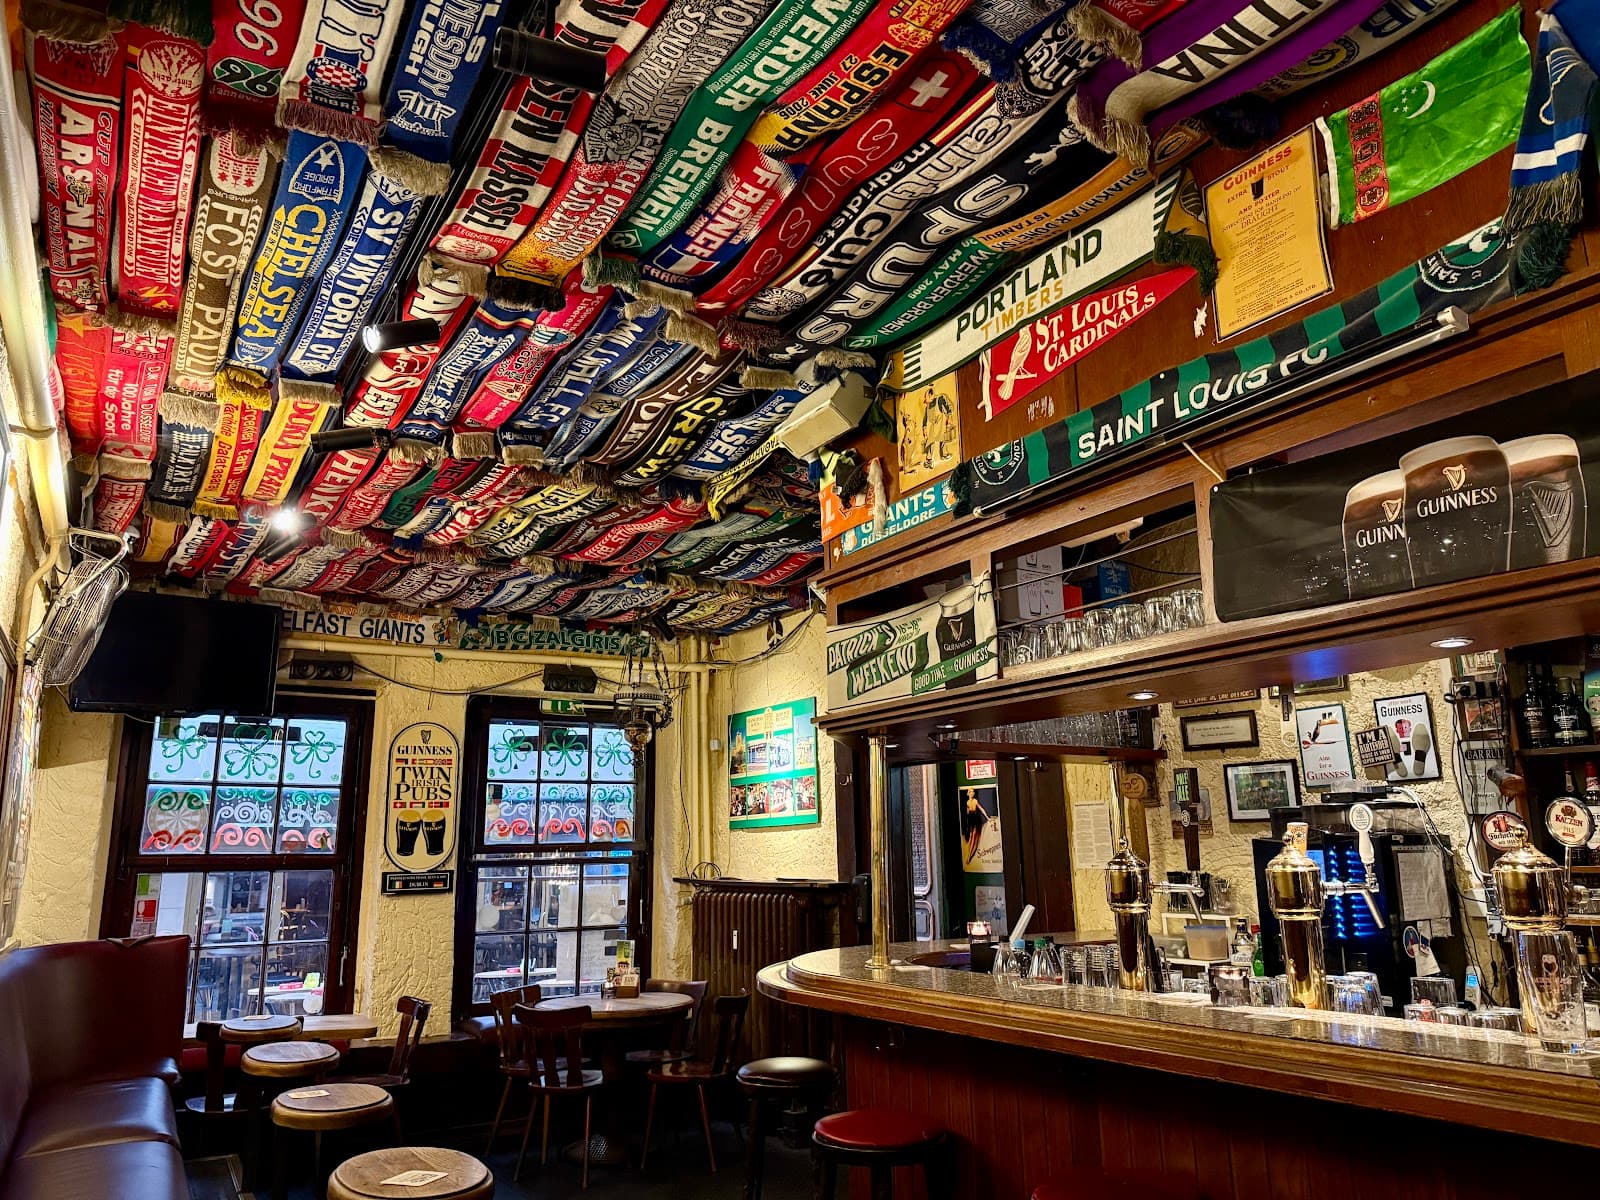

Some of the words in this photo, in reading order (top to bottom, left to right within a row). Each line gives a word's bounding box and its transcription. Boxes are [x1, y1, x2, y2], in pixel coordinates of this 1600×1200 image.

[212, 56, 279, 97] 96
[620, 5, 706, 121] SONDERZUG
[714, 0, 849, 115] WERDER
[839, 53, 859, 73] 27
[780, 97, 810, 121] 2006
[809, 72, 839, 100] JUNE
[97, 111, 114, 168] CUP
[140, 94, 191, 197] EINTRACHT
[60, 103, 96, 269] ARSNAL
[292, 179, 341, 199] STAMFORD
[302, 170, 336, 186] BRIDGE
[460, 140, 552, 231] KASSEL
[617, 146, 652, 187] NACH
[627, 115, 736, 232] BREMEN
[1223, 146, 1293, 191] GUINNESS
[1227, 188, 1248, 204] EXTRA
[1267, 164, 1290, 182] STOUT
[682, 166, 783, 260] FRANCE
[813, 141, 932, 248] madridista
[1240, 204, 1280, 230] DRAUGHT
[134, 194, 177, 285] FRANKFURT
[206, 203, 250, 248] FC
[363, 206, 406, 247] SV
[976, 211, 1050, 242] ISTANBUL
[243, 204, 328, 339] CHELSEA
[796, 174, 1030, 346] SPURS
[935, 248, 965, 278] MAY
[936, 248, 996, 301] WERDER
[315, 252, 386, 342] VIKTORIA
[956, 227, 1103, 343] PORTLAND
[301, 289, 328, 344] UNTERMAIN
[876, 288, 936, 337] BREMEN
[980, 280, 1064, 342] TIMBERS
[1035, 311, 1066, 353] ST.
[1071, 282, 1139, 331] LOUIS
[1042, 290, 1157, 374] CARDINALS
[184, 306, 227, 379] PAULI
[548, 320, 645, 400] MILLWALL
[1077, 398, 1166, 460] SAINT
[1173, 361, 1269, 420] LOUIS
[636, 396, 725, 479] CREW
[859, 487, 936, 534] GANTS
[1416, 486, 1498, 518] GUINNESS
[277, 611, 353, 636] ELFAST
[359, 617, 427, 645] GIANTS
[827, 621, 897, 672] PATRICK'S
[943, 638, 974, 652] GUINNESS
[850, 641, 918, 697] WEEKEND
[914, 673, 931, 692] GOOD
[930, 664, 948, 683] TIME
[952, 646, 990, 673] GUINNESS
[1380, 704, 1423, 718] GUINNESS
[397, 744, 453, 756] GUINNESS
[1357, 730, 1377, 745] I'M
[1466, 749, 1485, 760] BAR
[395, 766, 454, 785] TWIN
[395, 782, 452, 801] PUBS
[411, 779, 441, 788] IRISH
[1306, 770, 1350, 781] GUINNESS
